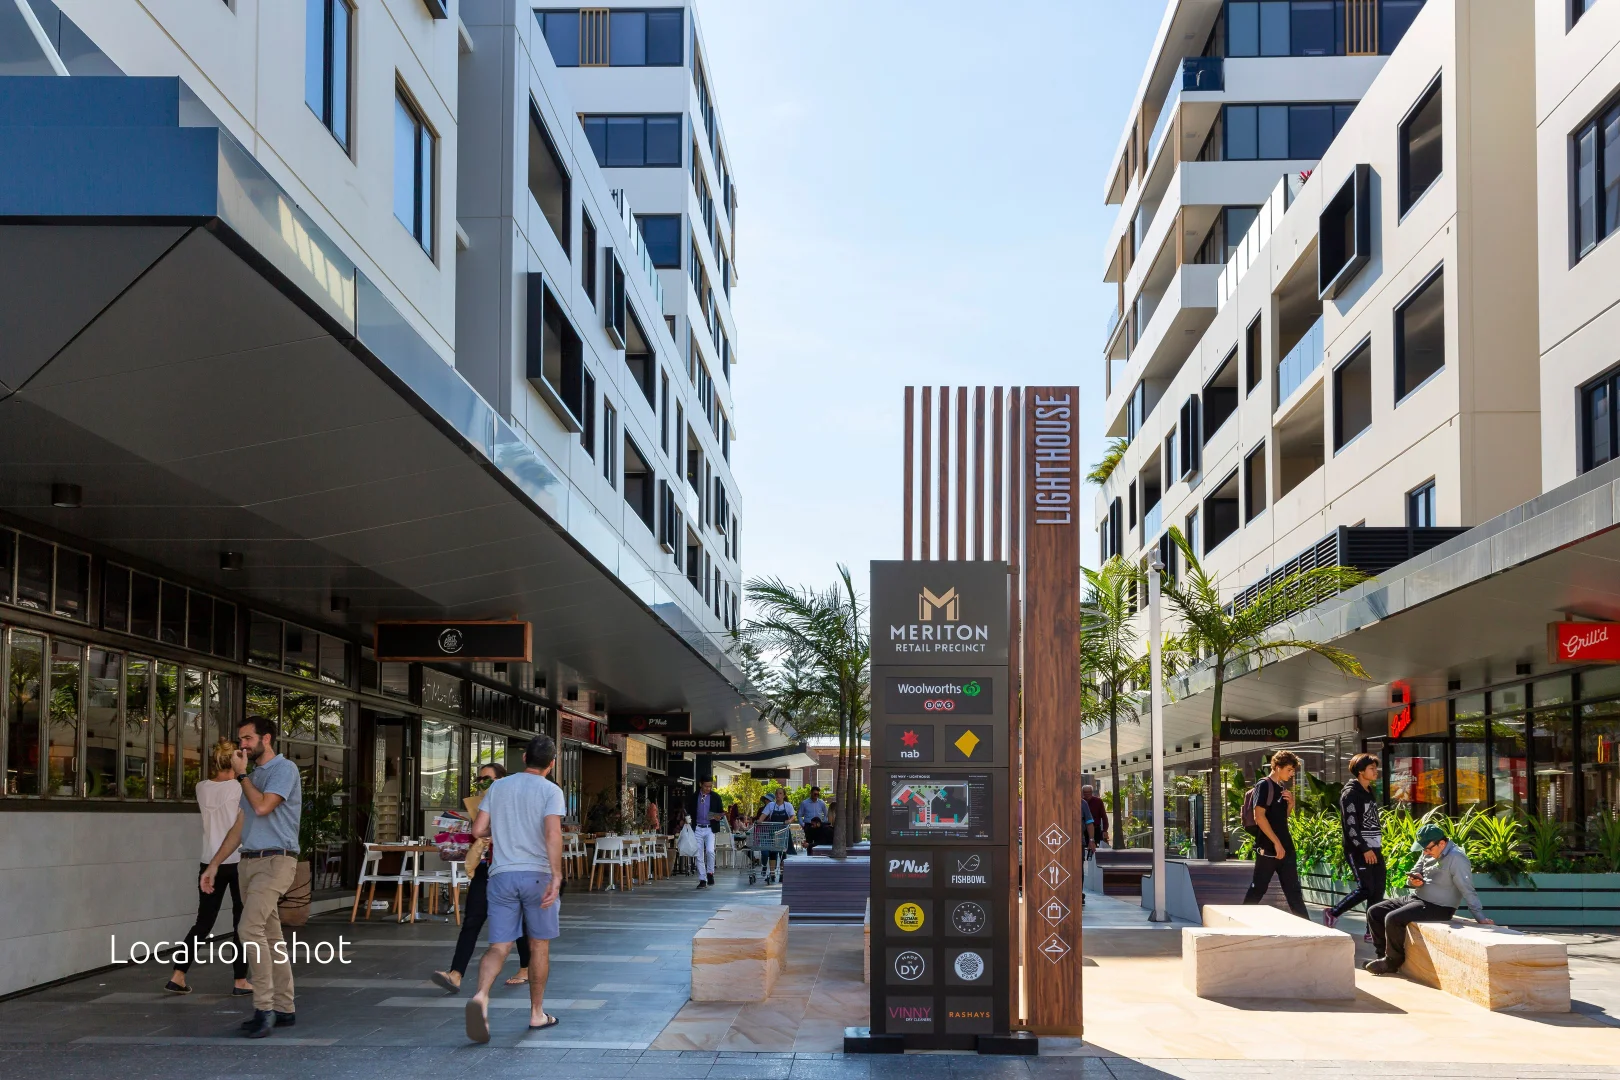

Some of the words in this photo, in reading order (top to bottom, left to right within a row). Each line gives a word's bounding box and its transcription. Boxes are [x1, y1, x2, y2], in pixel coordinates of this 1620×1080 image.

[1036, 394, 1070, 524] LIGHTHOUSE
[890, 624, 988, 640] MERITON
[1562, 626, 1609, 658] Grill'd
[896, 644, 930, 652] RETAIL
[934, 644, 986, 652] PRECINCT
[897, 683, 962, 694] Woolworths
[1229, 726, 1272, 736] Woolworths
[900, 750, 920, 758] nab
[888, 860, 930, 873] P'Nut
[951, 875, 986, 884] FISHBOWL
[901, 965, 918, 974] DY
[889, 1006, 931, 1018] VINNY
